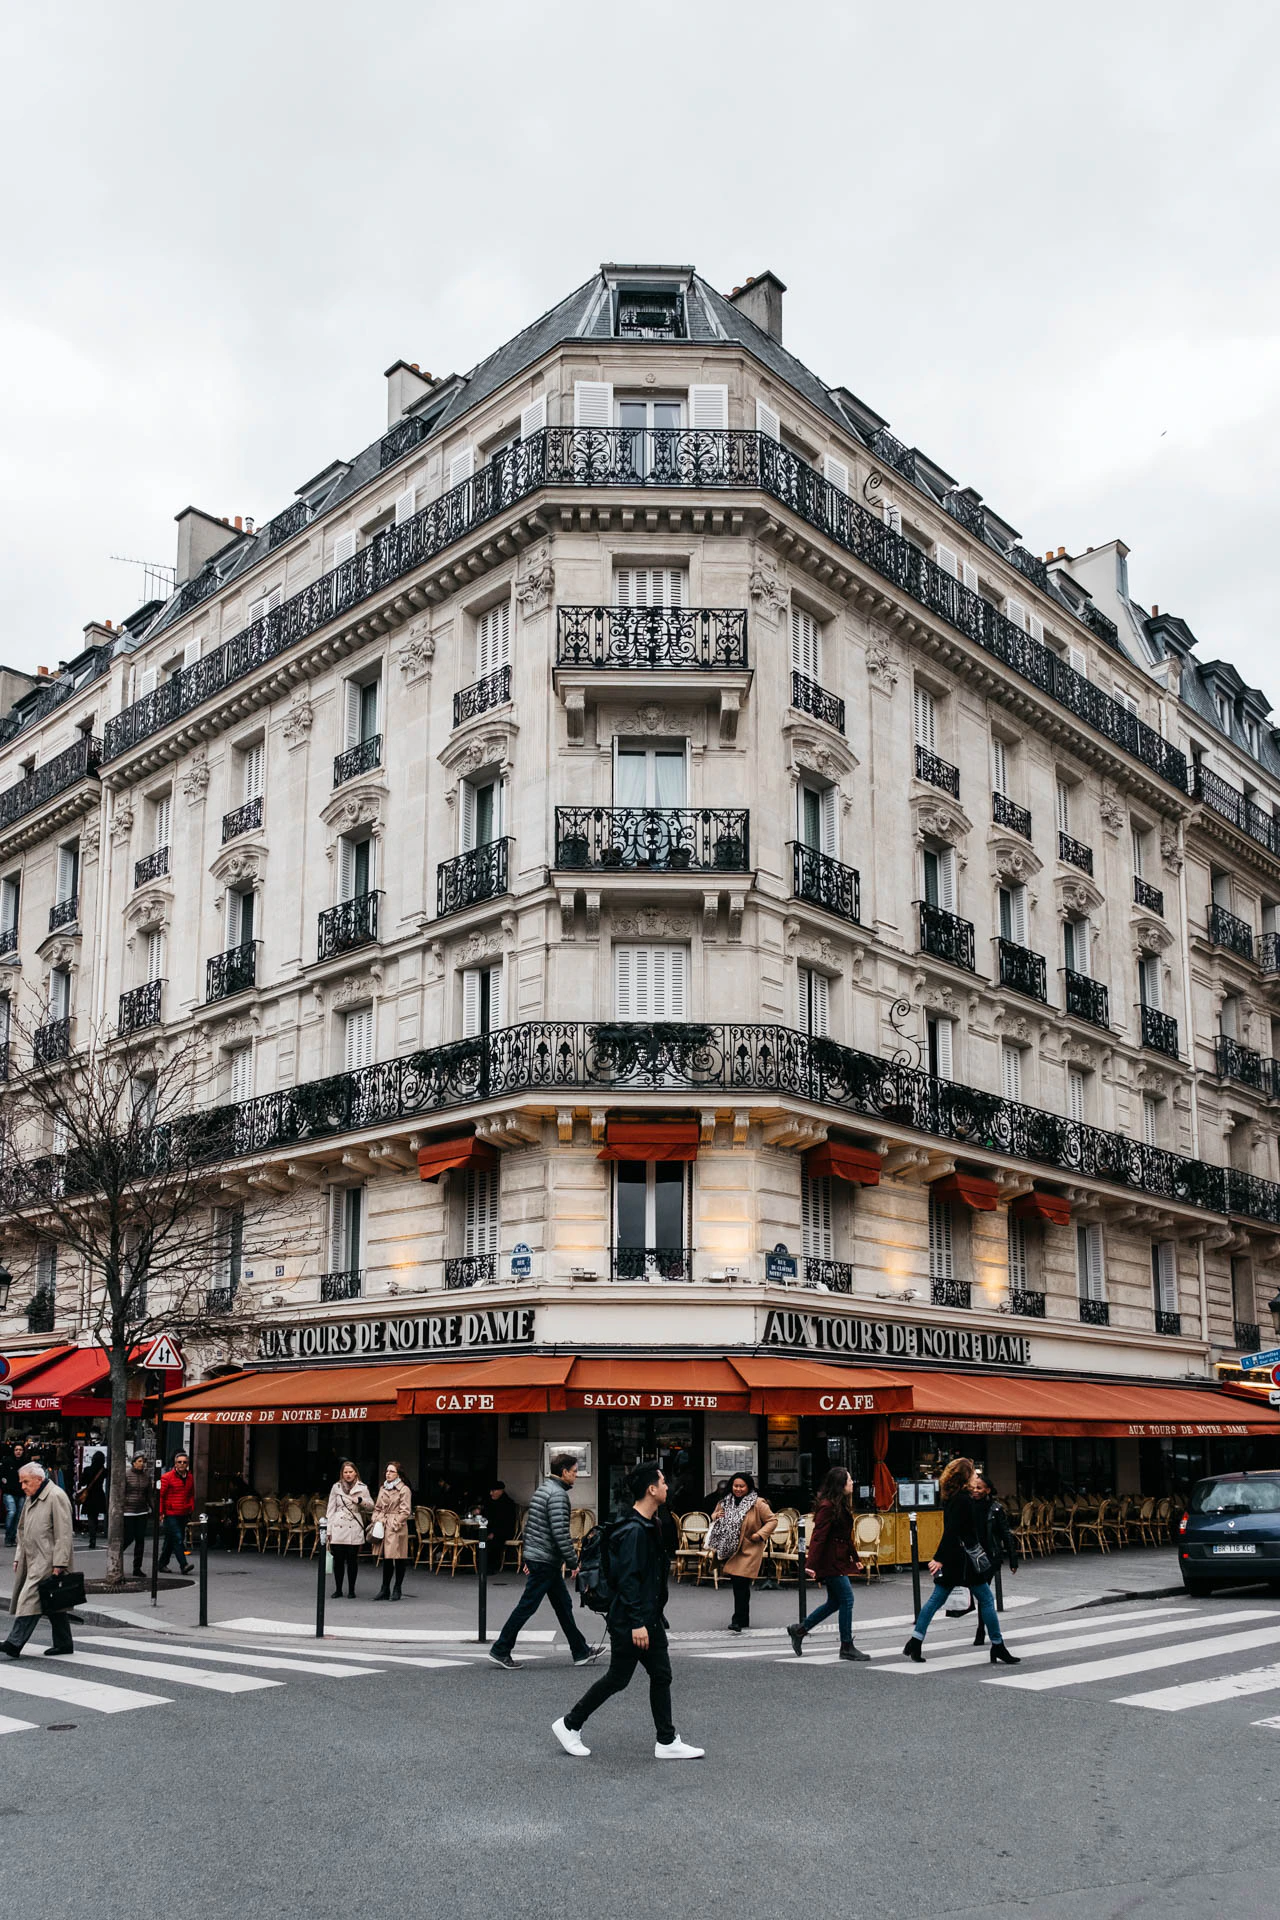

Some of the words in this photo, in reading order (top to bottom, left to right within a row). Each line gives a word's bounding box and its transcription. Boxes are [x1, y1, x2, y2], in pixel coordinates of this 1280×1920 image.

[257, 1328, 289, 1358] AUX
[293, 1324, 353, 1354] TOURS
[357, 1322, 382, 1352] DE
[387, 1315, 459, 1351] NOTRE
[464, 1310, 532, 1344] DAME
[766, 1311, 815, 1346] AUX
[818, 1316, 887, 1352] TOURS
[892, 1325, 916, 1354] DE
[922, 1327, 982, 1360] NOTRE
[986, 1334, 1031, 1363] DAME
[35, 1398, 60, 1408] NOTRE
[435, 1394, 495, 1411] CAFE
[583, 1393, 642, 1407] SALON
[650, 1395, 674, 1407] DE
[683, 1396, 718, 1408] THE
[819, 1394, 874, 1411] CAFE
[184, 1412, 211, 1421] AUX
[215, 1412, 253, 1422] TOURS
[258, 1411, 275, 1422] DE
[1128, 1425, 1146, 1435] AUX
[1149, 1425, 1177, 1435] TOURS
[1181, 1425, 1194, 1434] DE
